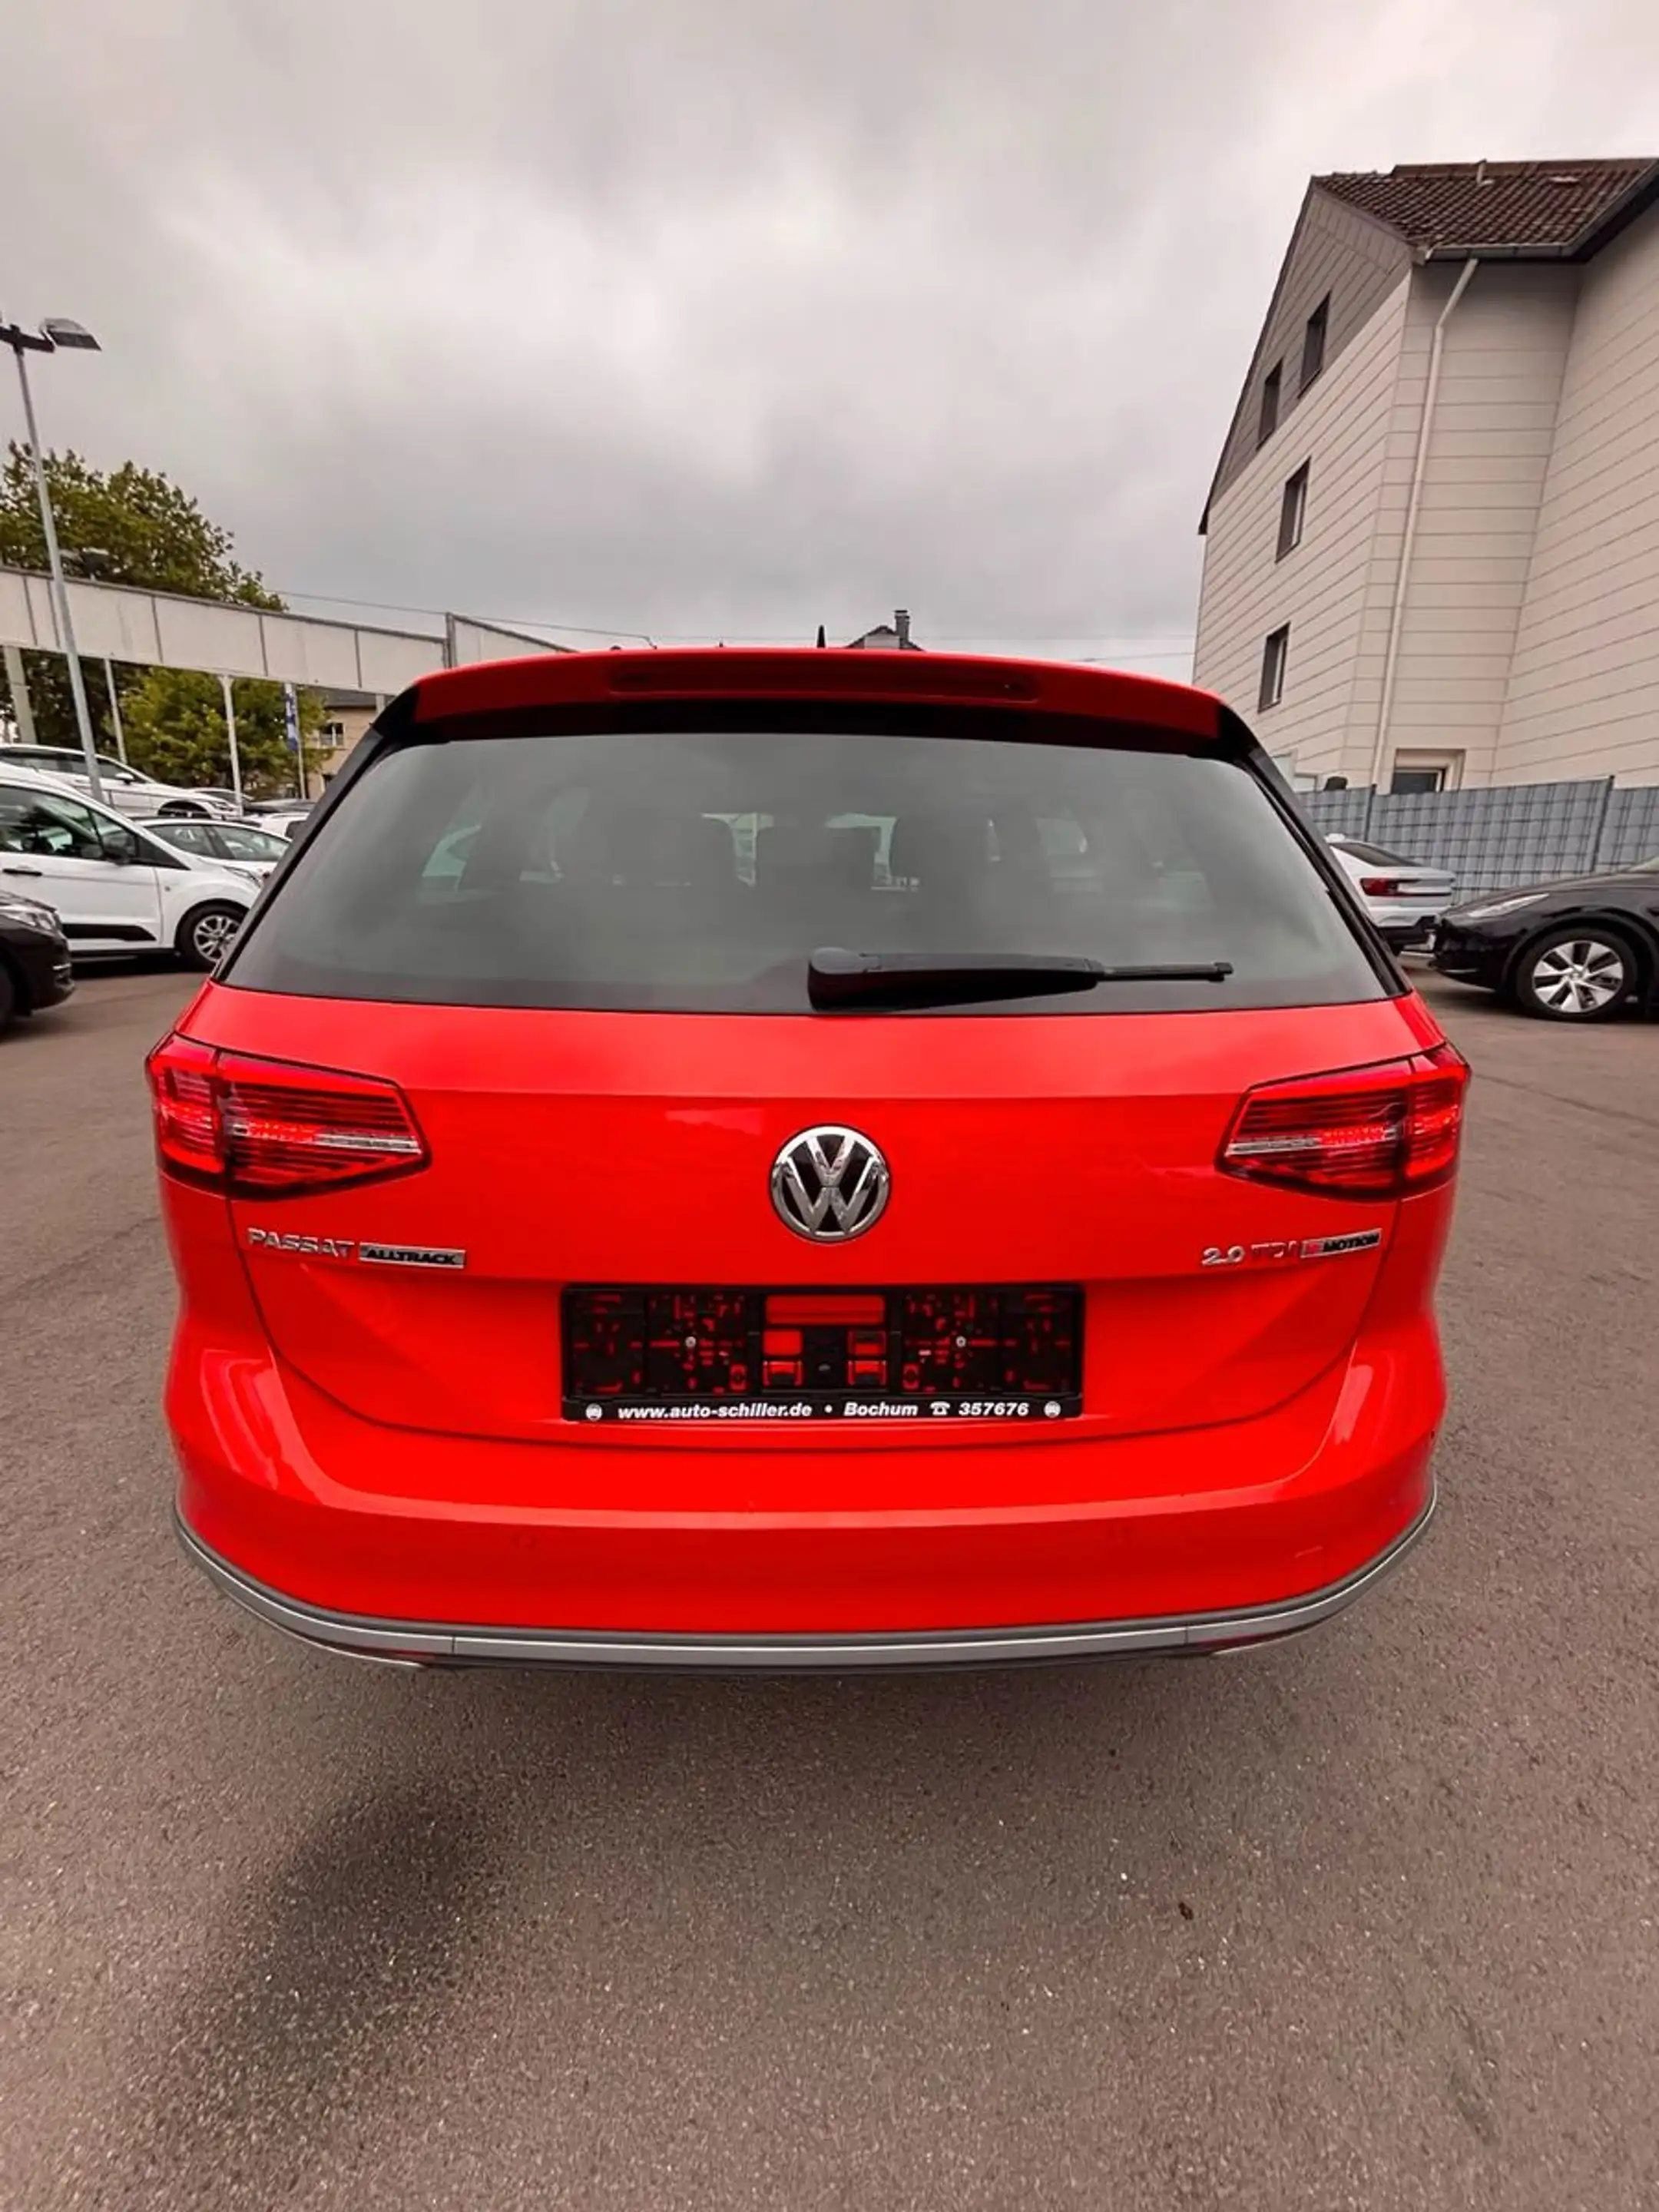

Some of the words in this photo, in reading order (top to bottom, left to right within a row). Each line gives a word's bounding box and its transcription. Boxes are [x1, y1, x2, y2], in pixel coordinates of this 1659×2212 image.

[247, 1228, 354, 1257] PASSAT
[364, 1248, 457, 1265] ALLTRACK
[1201, 1245, 1245, 1265] 2.0
[1250, 1240, 1297, 1260] TDI
[617, 1402, 813, 1419] www.auto-schiller.de
[843, 1401, 919, 1417] Bochum
[958, 1401, 1030, 1417] 357676
